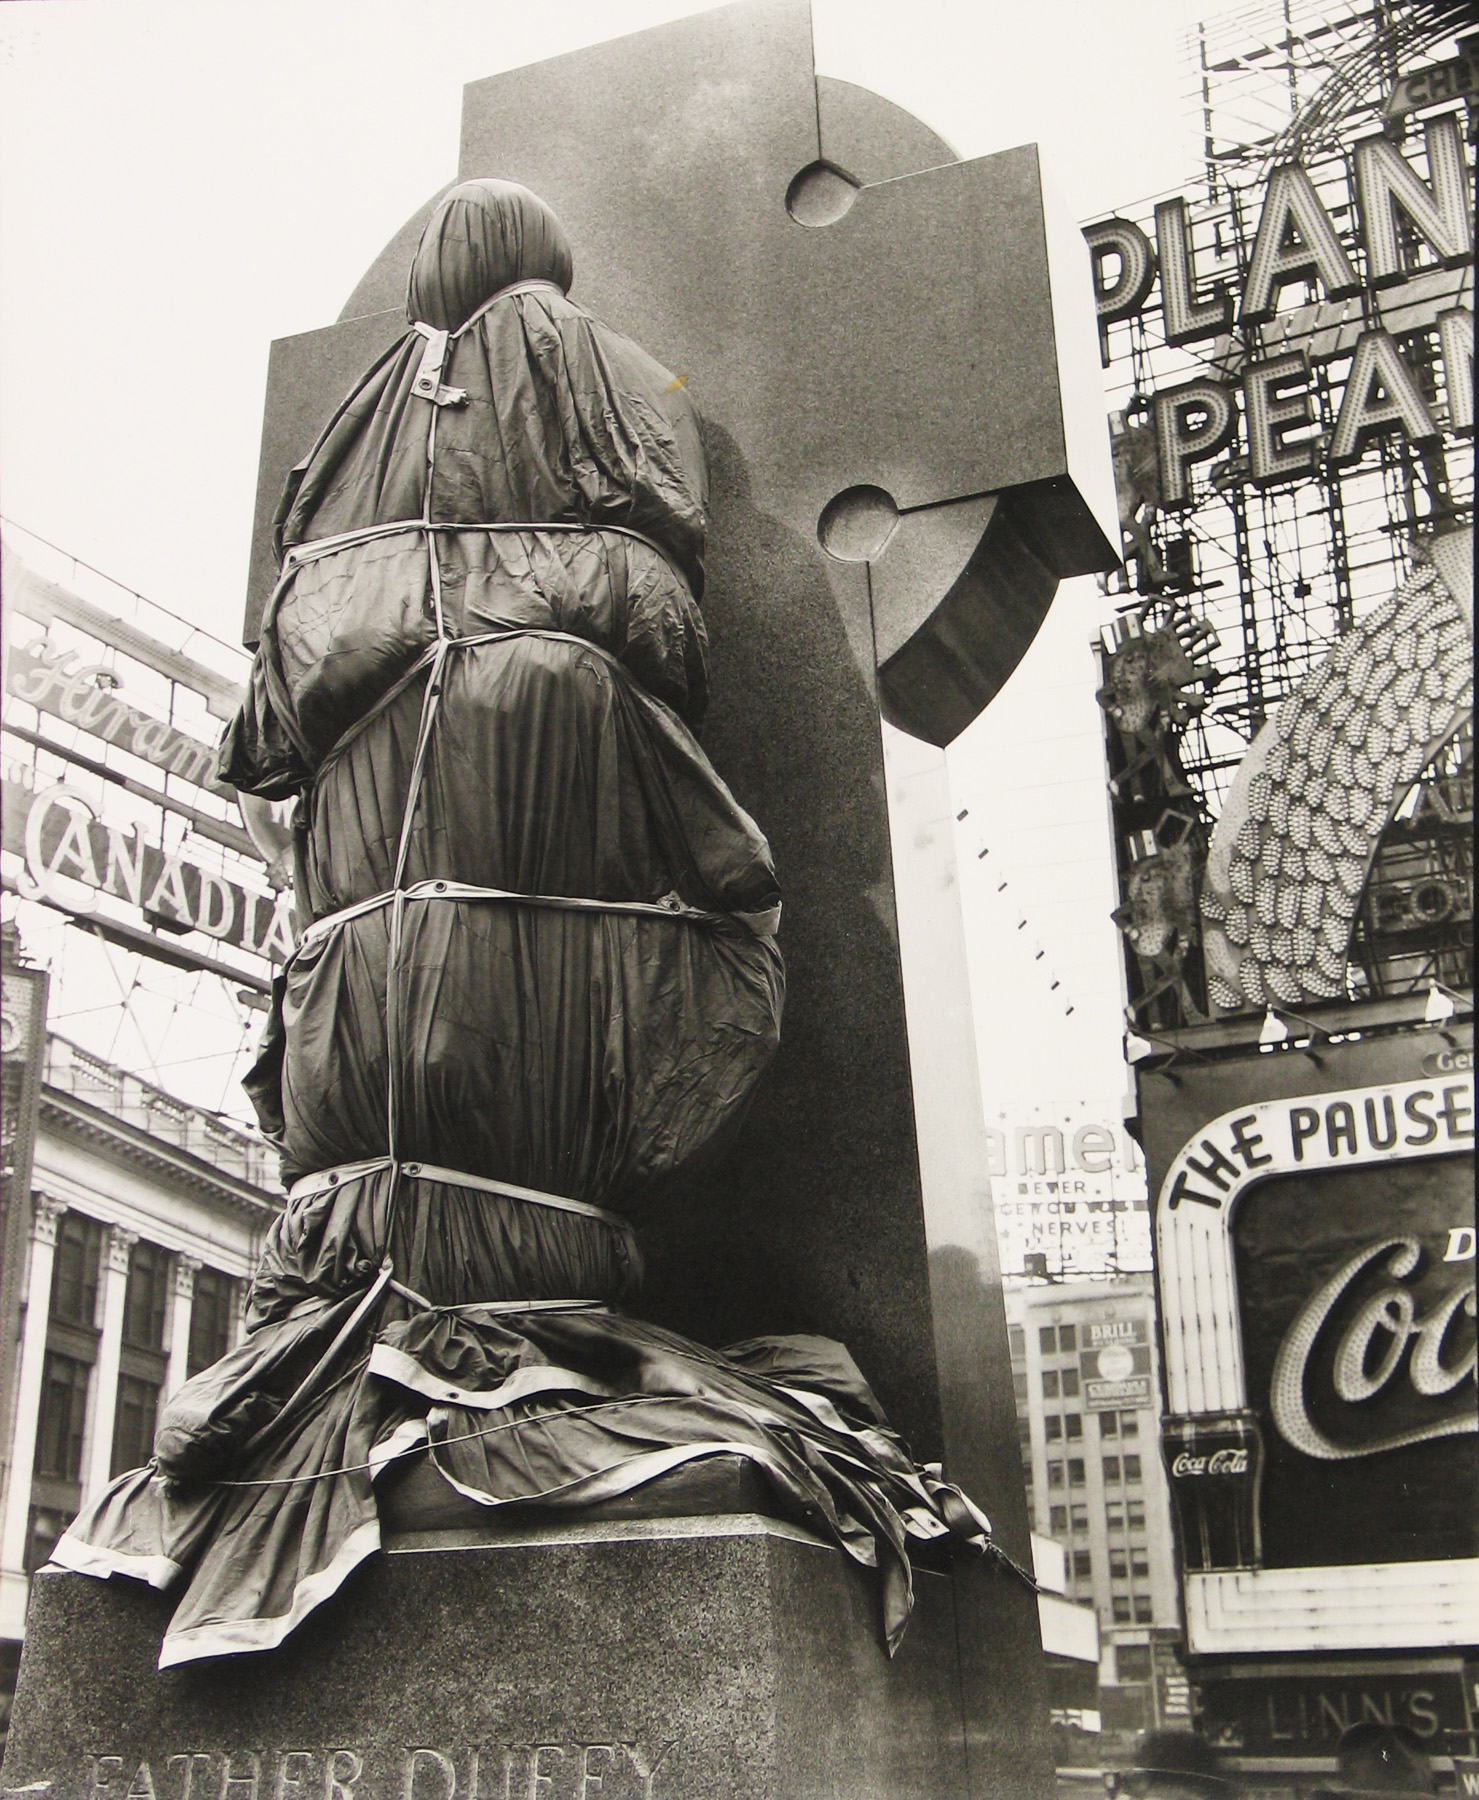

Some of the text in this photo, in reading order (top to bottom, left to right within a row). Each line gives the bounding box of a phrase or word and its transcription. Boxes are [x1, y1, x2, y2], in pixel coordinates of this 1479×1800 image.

[1169, 1085, 1474, 1210] THE PAUSE
[1172, 1449, 1248, 1477] Coca Cola
